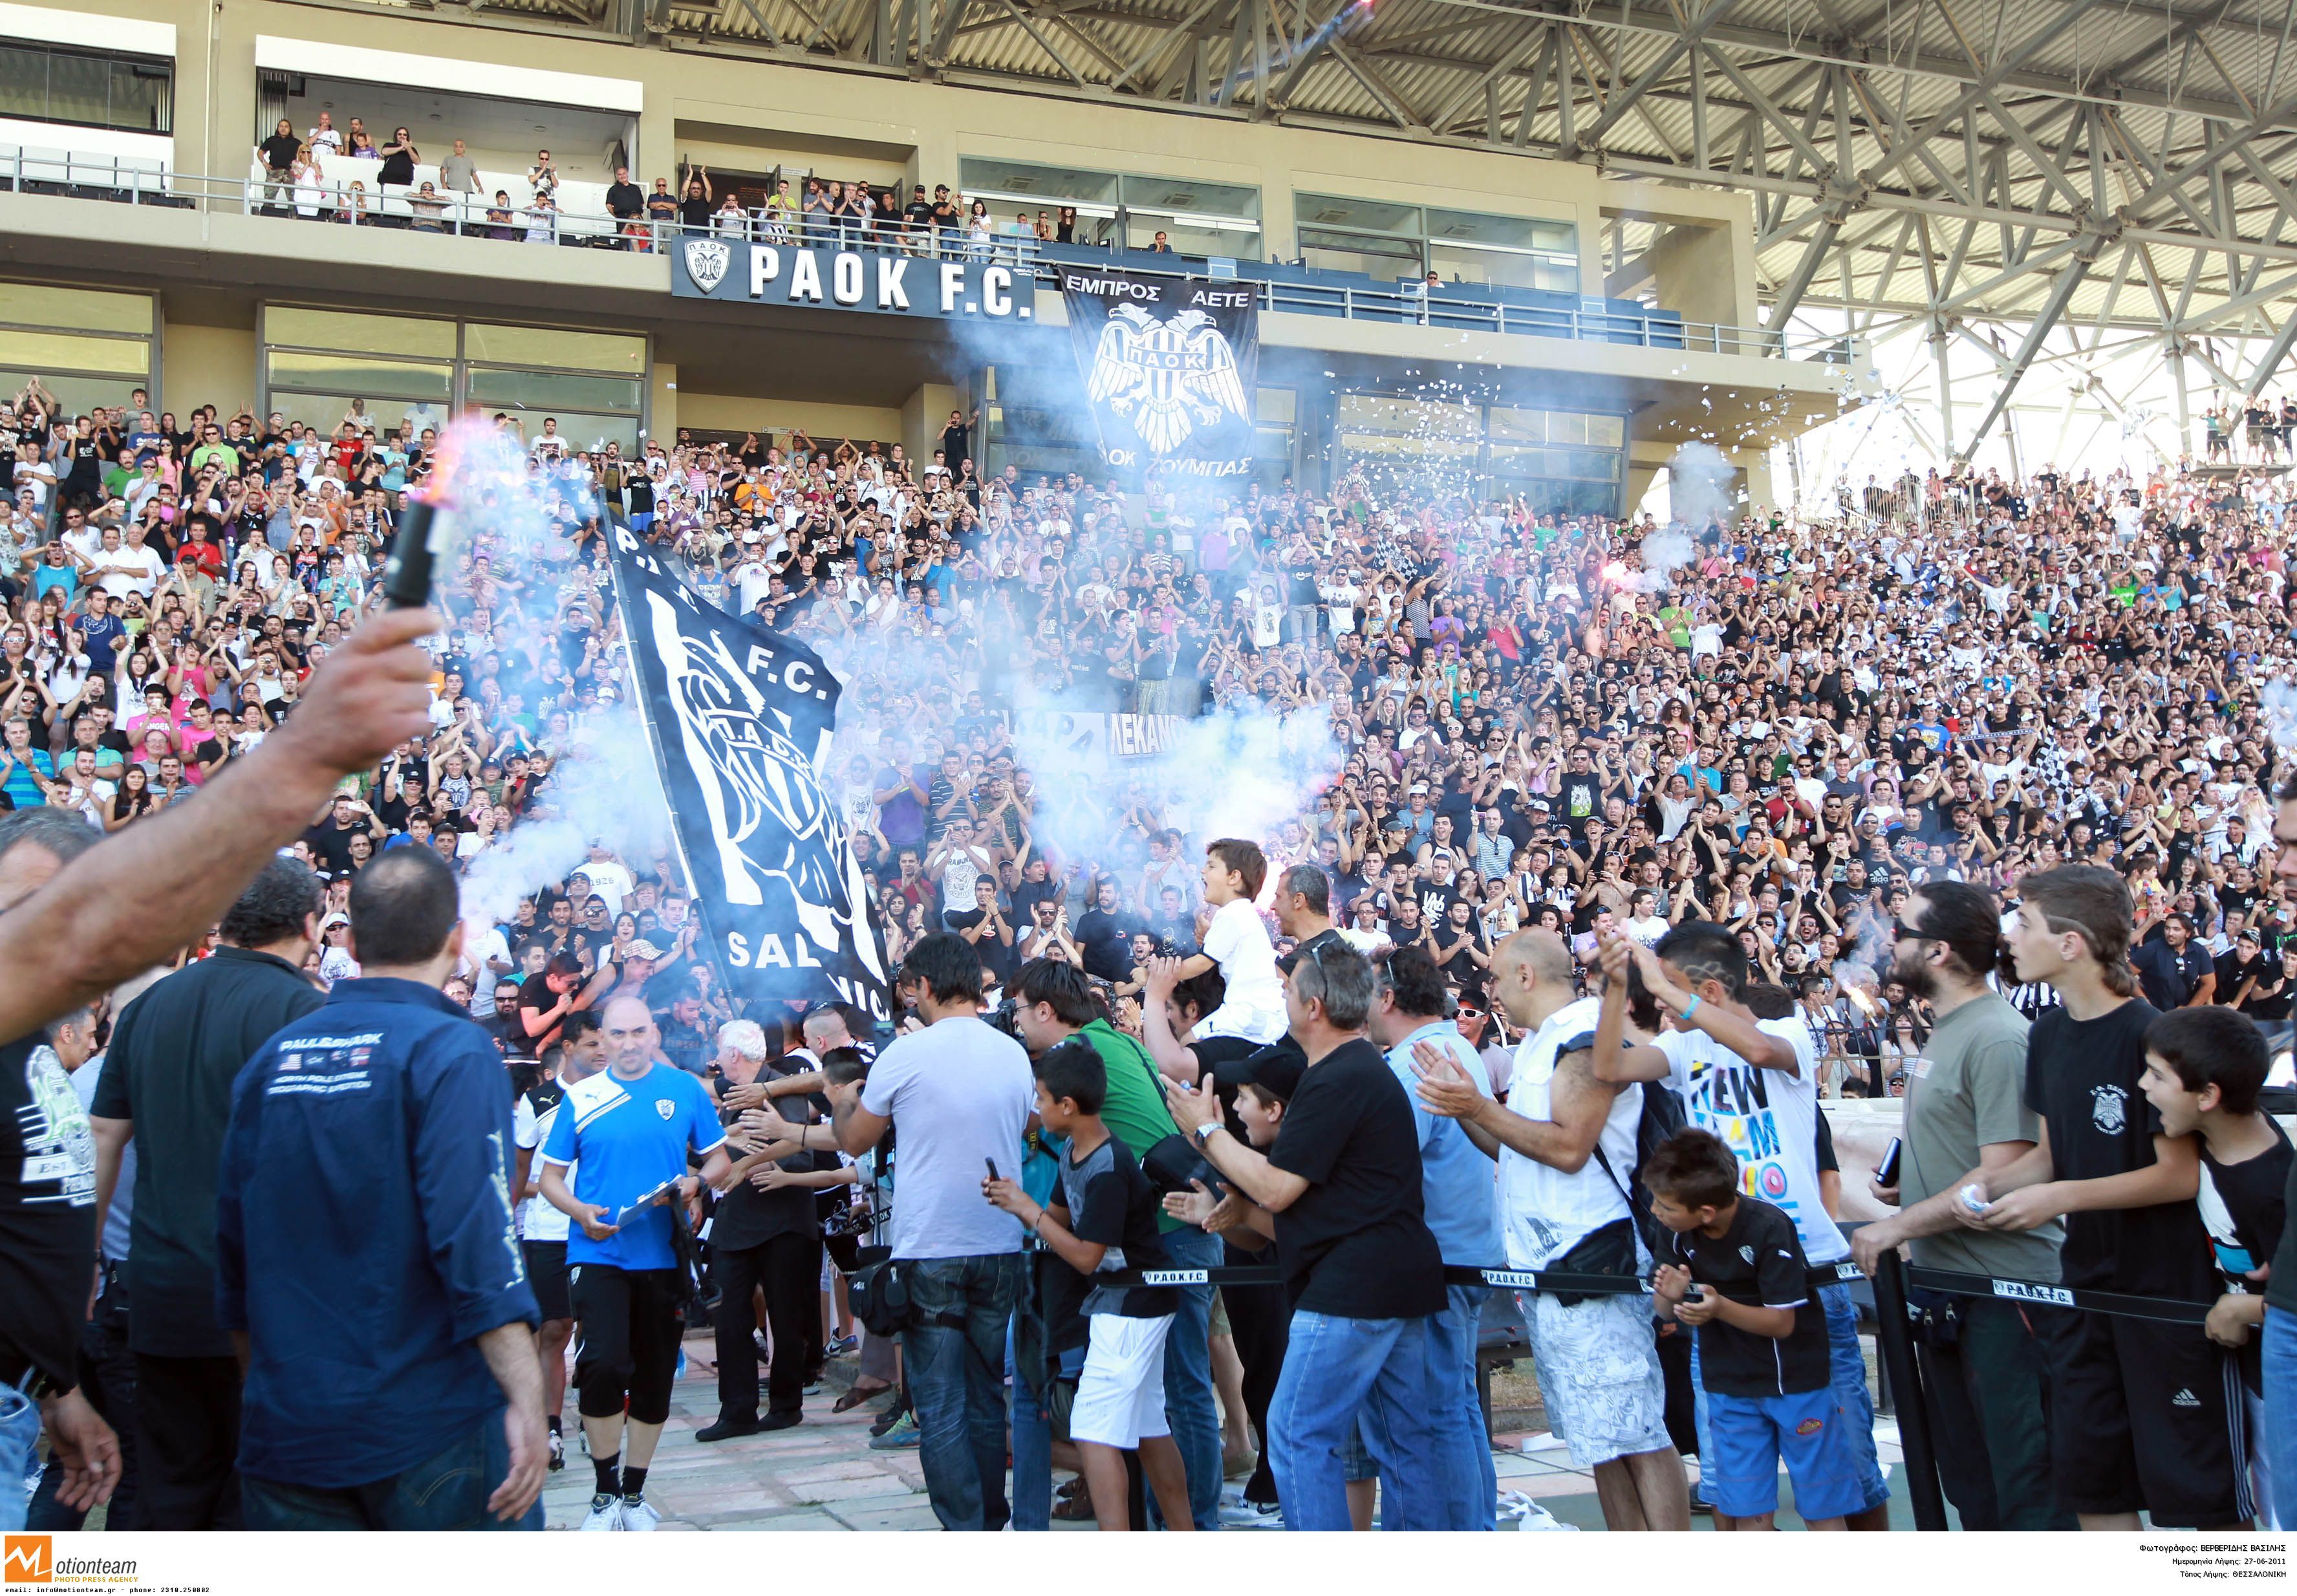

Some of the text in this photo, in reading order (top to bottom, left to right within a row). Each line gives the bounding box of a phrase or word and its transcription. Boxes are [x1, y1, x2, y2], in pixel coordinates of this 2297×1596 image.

[689, 243, 727, 253] ΠΑΟΚ
[749, 245, 1031, 320] PAOK F.C.
[1066, 275, 1249, 308] ΕΜΠΡΟΣ ΑΕΤΕ
[1129, 345, 1205, 371] ΠΑΟΚ
[746, 644, 828, 701] F.C.
[590, 878, 614, 887] 1926
[1154, 1272, 1205, 1282] P.A.O.K. F.C.
[1489, 1273, 1532, 1285] P.A.O.K. F.C.
